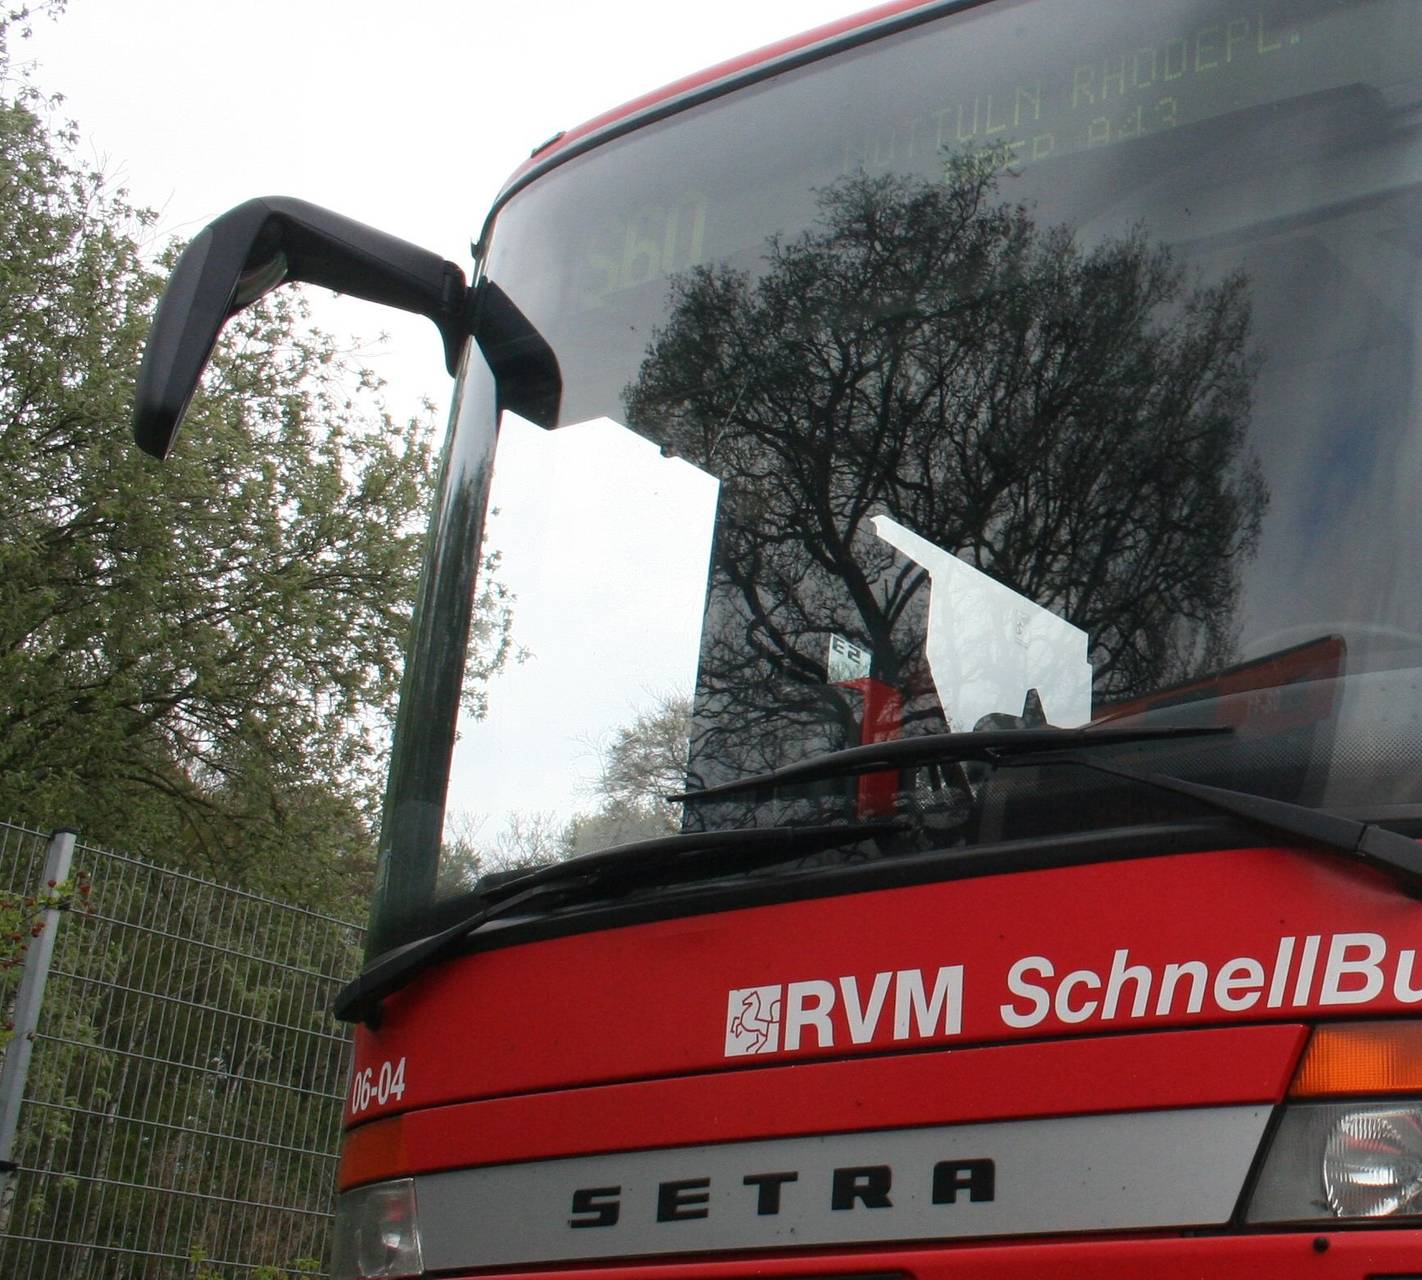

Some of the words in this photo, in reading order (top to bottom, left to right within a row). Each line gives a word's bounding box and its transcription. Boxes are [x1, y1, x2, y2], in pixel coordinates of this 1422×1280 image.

[784, 964, 965, 1052] RVM
[352, 1056, 406, 1114] 06-04
[569, 1157, 997, 1229] SETRA
